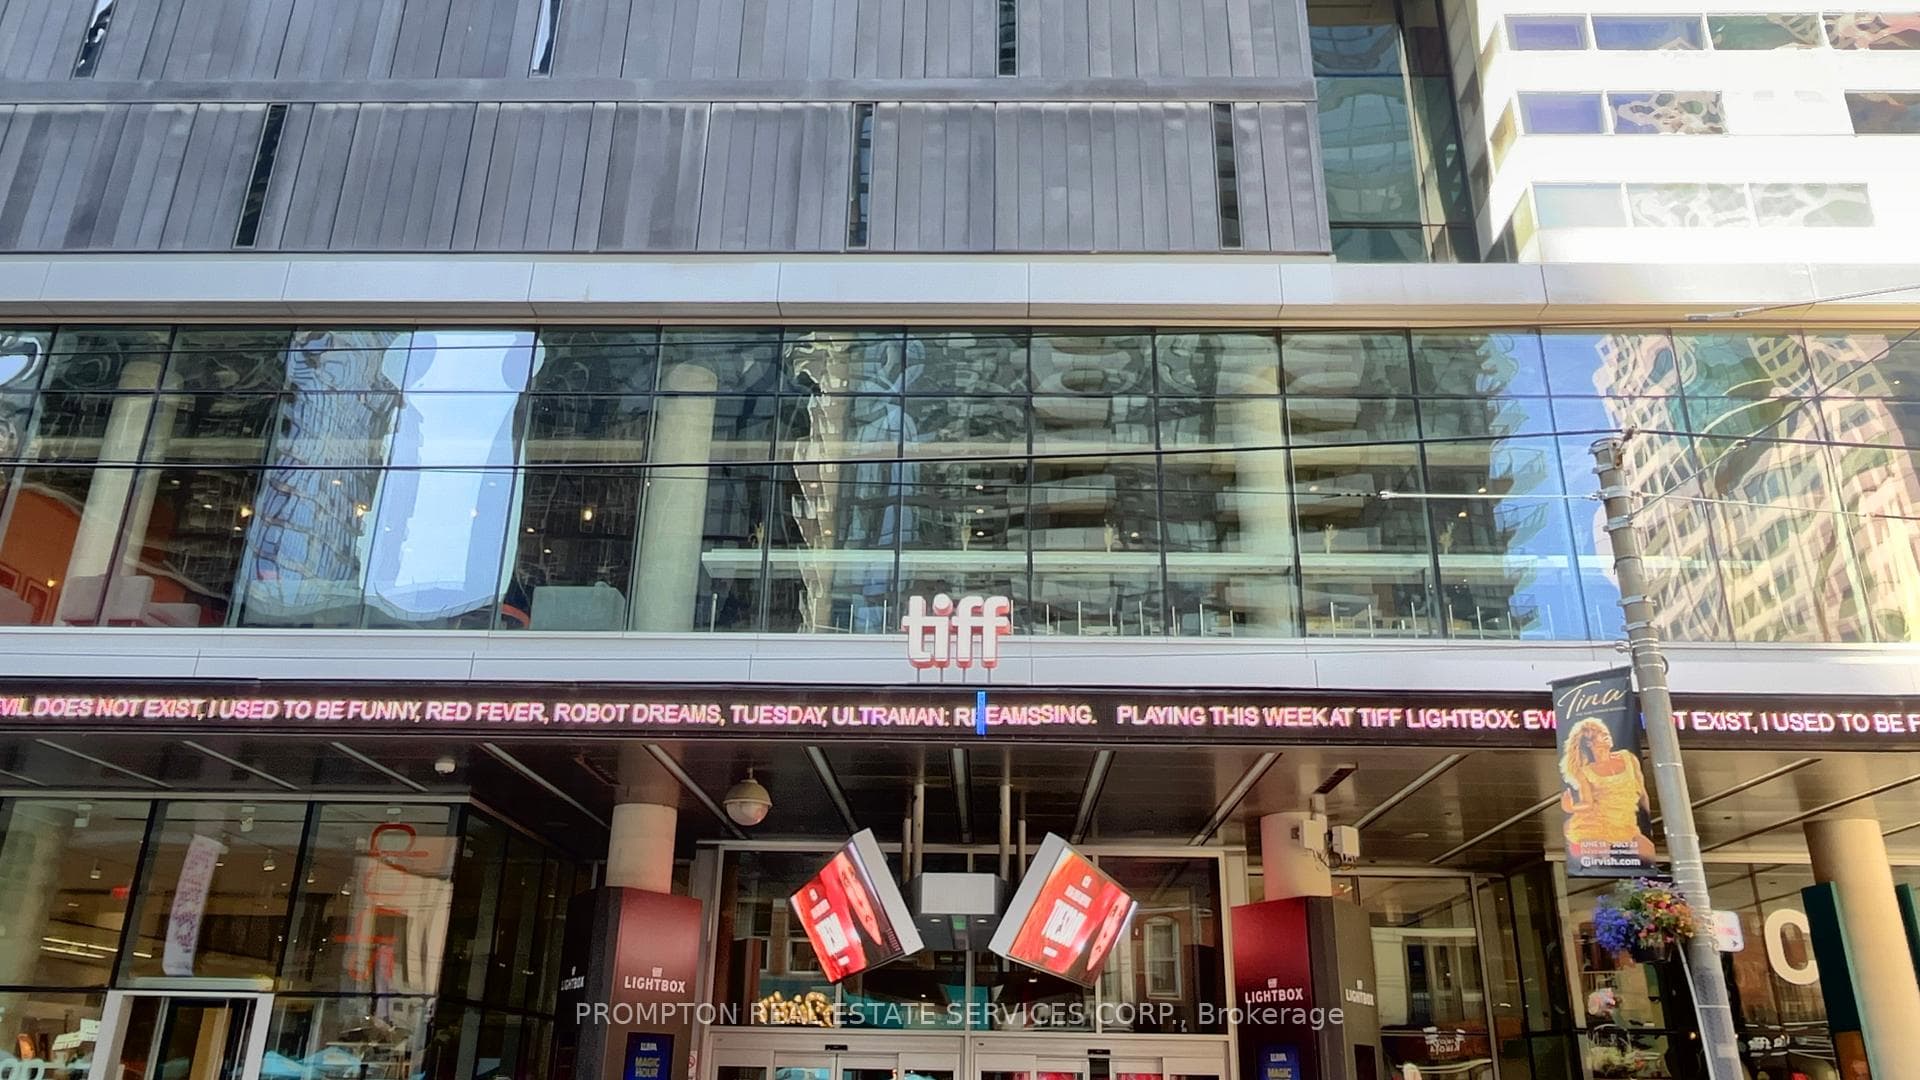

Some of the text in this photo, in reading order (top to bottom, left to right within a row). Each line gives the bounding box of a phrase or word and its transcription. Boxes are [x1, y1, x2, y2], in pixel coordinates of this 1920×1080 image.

[901, 593, 1012, 668] tiff
[1557, 680, 1628, 720] Tina
[33, 697, 95, 717] DOES
[95, 698, 139, 718] NOT
[143, 698, 205, 721] EXIST,
[207, 699, 216, 719] I
[219, 699, 278, 719] USED
[283, 700, 313, 720] TO
[315, 700, 346, 720] BE
[347, 700, 422, 722] FUNNY,
[425, 702, 472, 721] RED
[475, 702, 549, 725] FEVER,
[553, 703, 631, 723] ROBOT
[632, 704, 726, 727] DREAMS,
[730, 705, 828, 727] TUESDAY,
[832, 706, 949, 727] ULTRAMAN:
[1117, 705, 1207, 726] PLAYING
[1209, 706, 1260, 726] THIS
[1262, 706, 1329, 727] WEEK
[1329, 707, 1355, 727] AT
[1357, 707, 1402, 727] TIFF
[1406, 708, 1520, 729] LIGHTBOX:
[1691, 711, 1759, 734] EXIST,
[1760, 712, 1768, 731] I
[1773, 712, 1835, 732] USED
[1837, 713, 1870, 733] TO
[1873, 713, 1905, 733] BE
[561, 976, 585, 991] LIGHTBOX
[624, 975, 686, 993] LIGHTBOX
[1245, 988, 1303, 1004] LIGHTBOX
[1345, 988, 1374, 1006] LIGHTBOX
